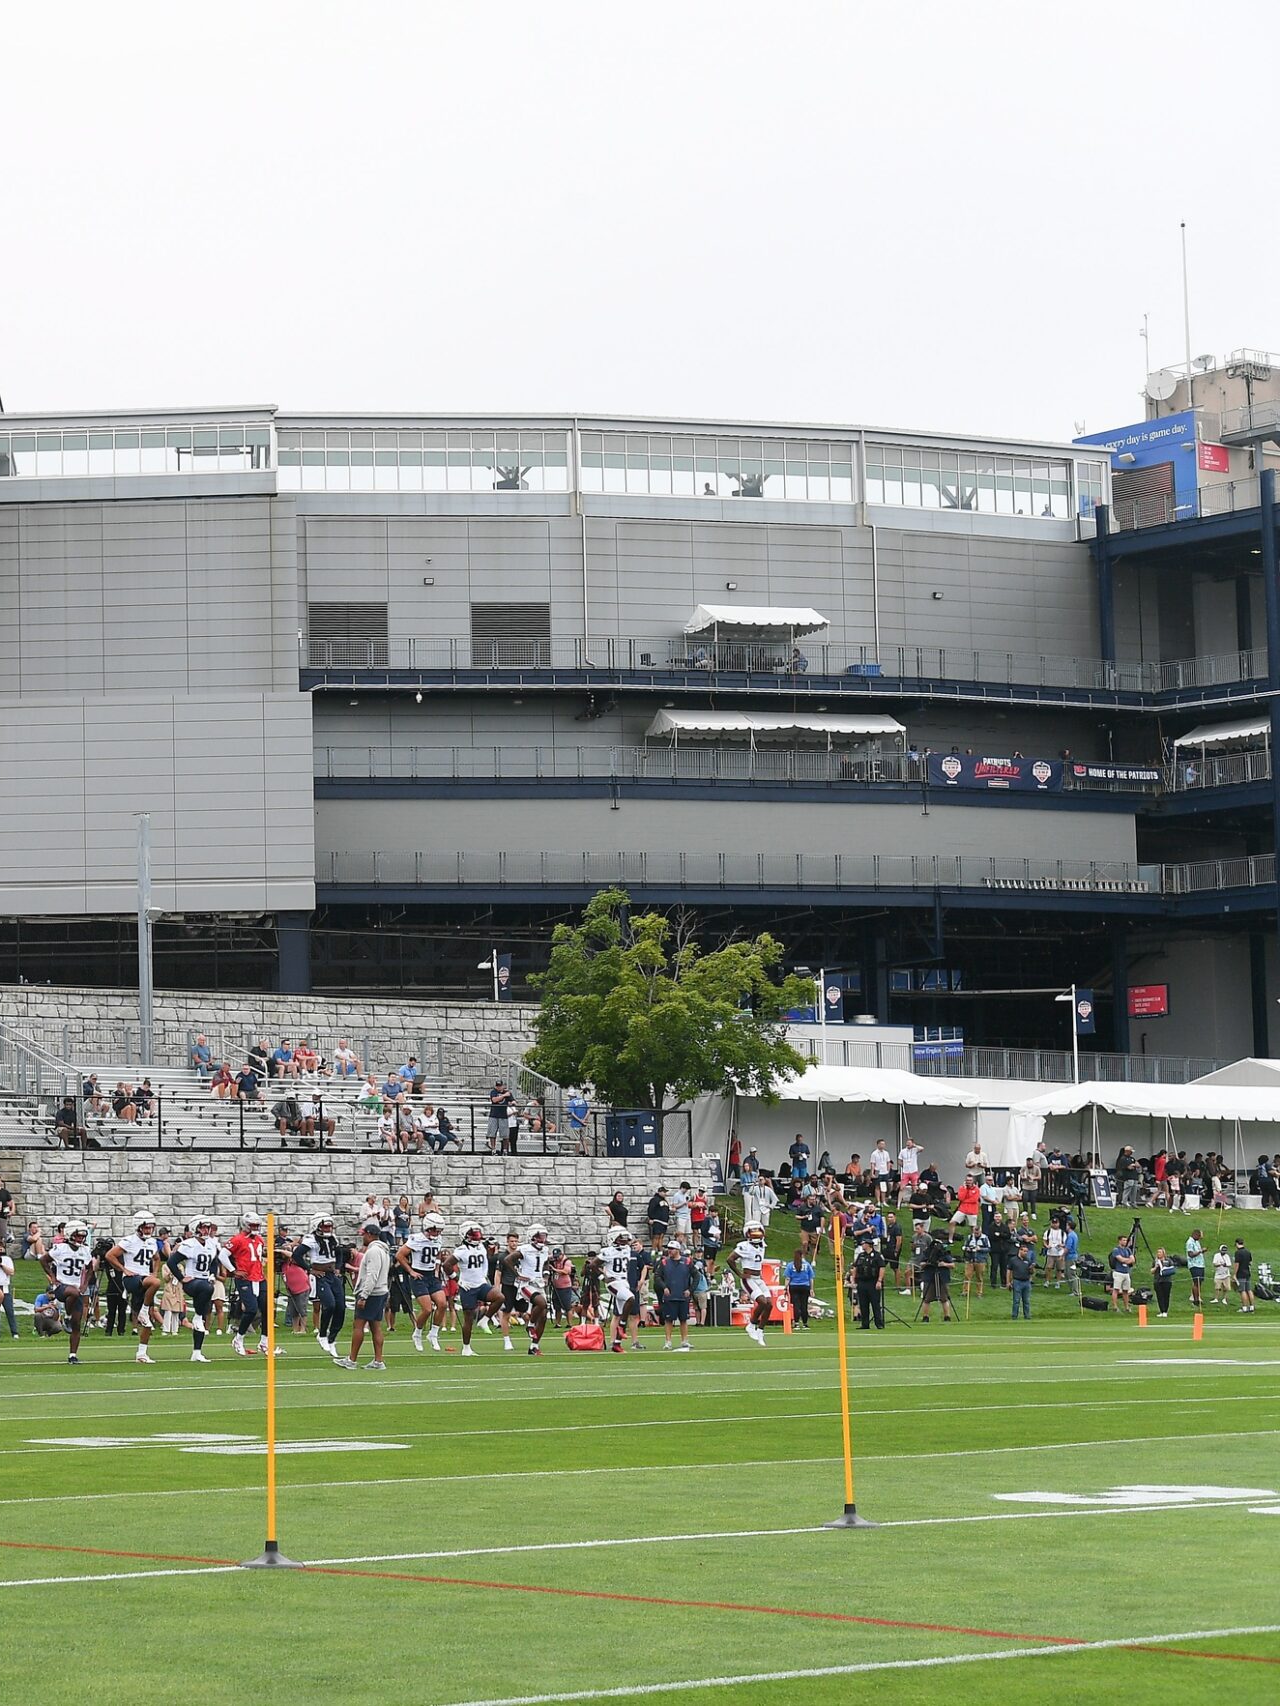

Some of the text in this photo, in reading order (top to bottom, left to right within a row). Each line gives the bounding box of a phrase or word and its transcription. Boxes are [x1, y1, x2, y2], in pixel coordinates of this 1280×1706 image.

[1126, 434, 1142, 446] day
[1149, 428, 1170, 442] game
[1171, 422, 1188, 435] day.
[982, 757, 1012, 767] PATRIOTS
[1088, 768, 1107, 778] HOME
[1107, 769, 1115, 778] OF
[1116, 770, 1128, 779] THE
[1129, 771, 1159, 780] PATRIOTS
[196, 1253, 212, 1272] 81
[421, 1246, 439, 1264] 85
[63, 1257, 85, 1277] 35
[534, 1256, 541, 1273] 1
[613, 1256, 629, 1273] 83
